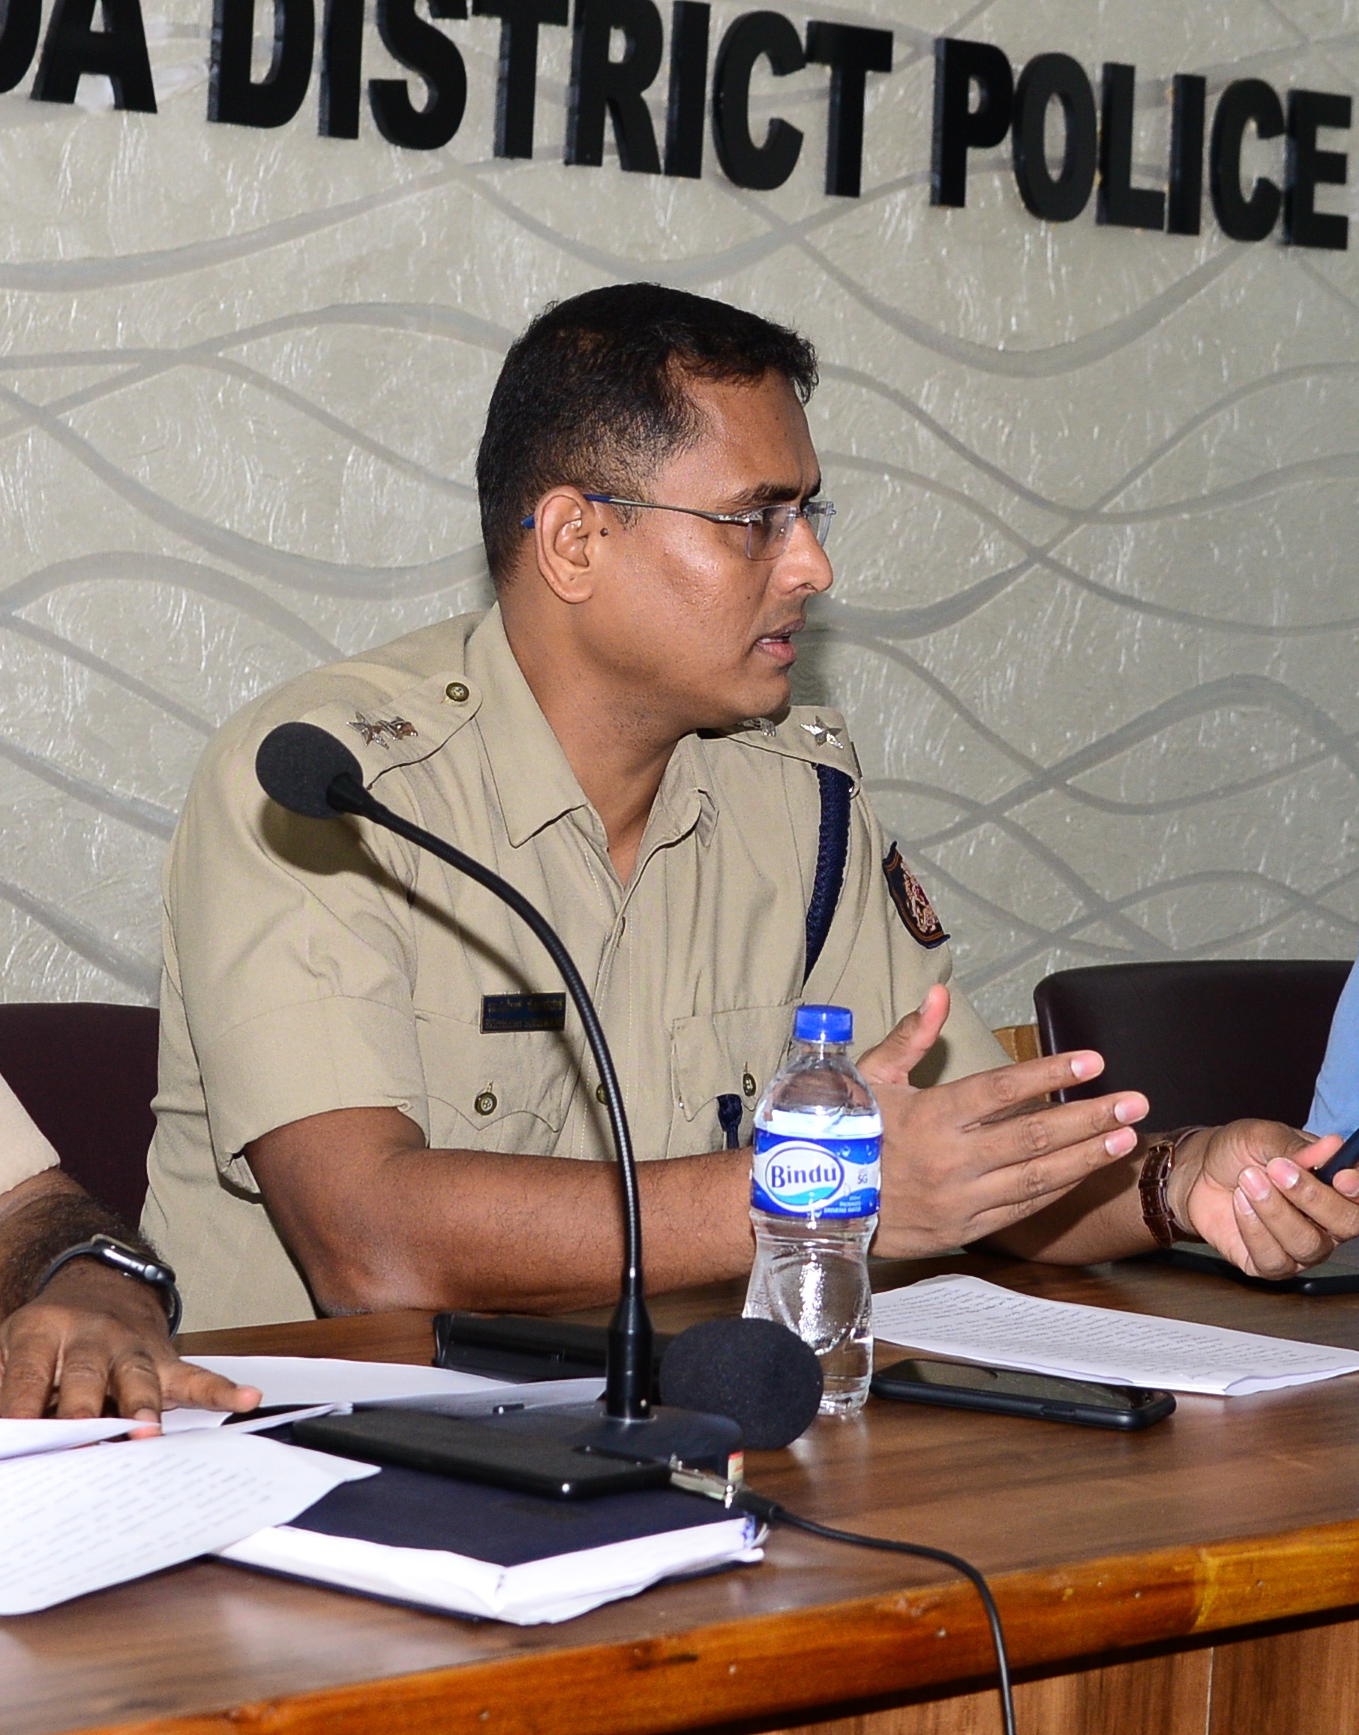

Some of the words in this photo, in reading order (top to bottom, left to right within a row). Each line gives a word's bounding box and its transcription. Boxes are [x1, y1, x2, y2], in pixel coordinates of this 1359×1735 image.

[207, 0, 894, 198] DISTRICT
[930, 37, 1352, 251] POLICE
[770, 1164, 837, 1189] Bindu
